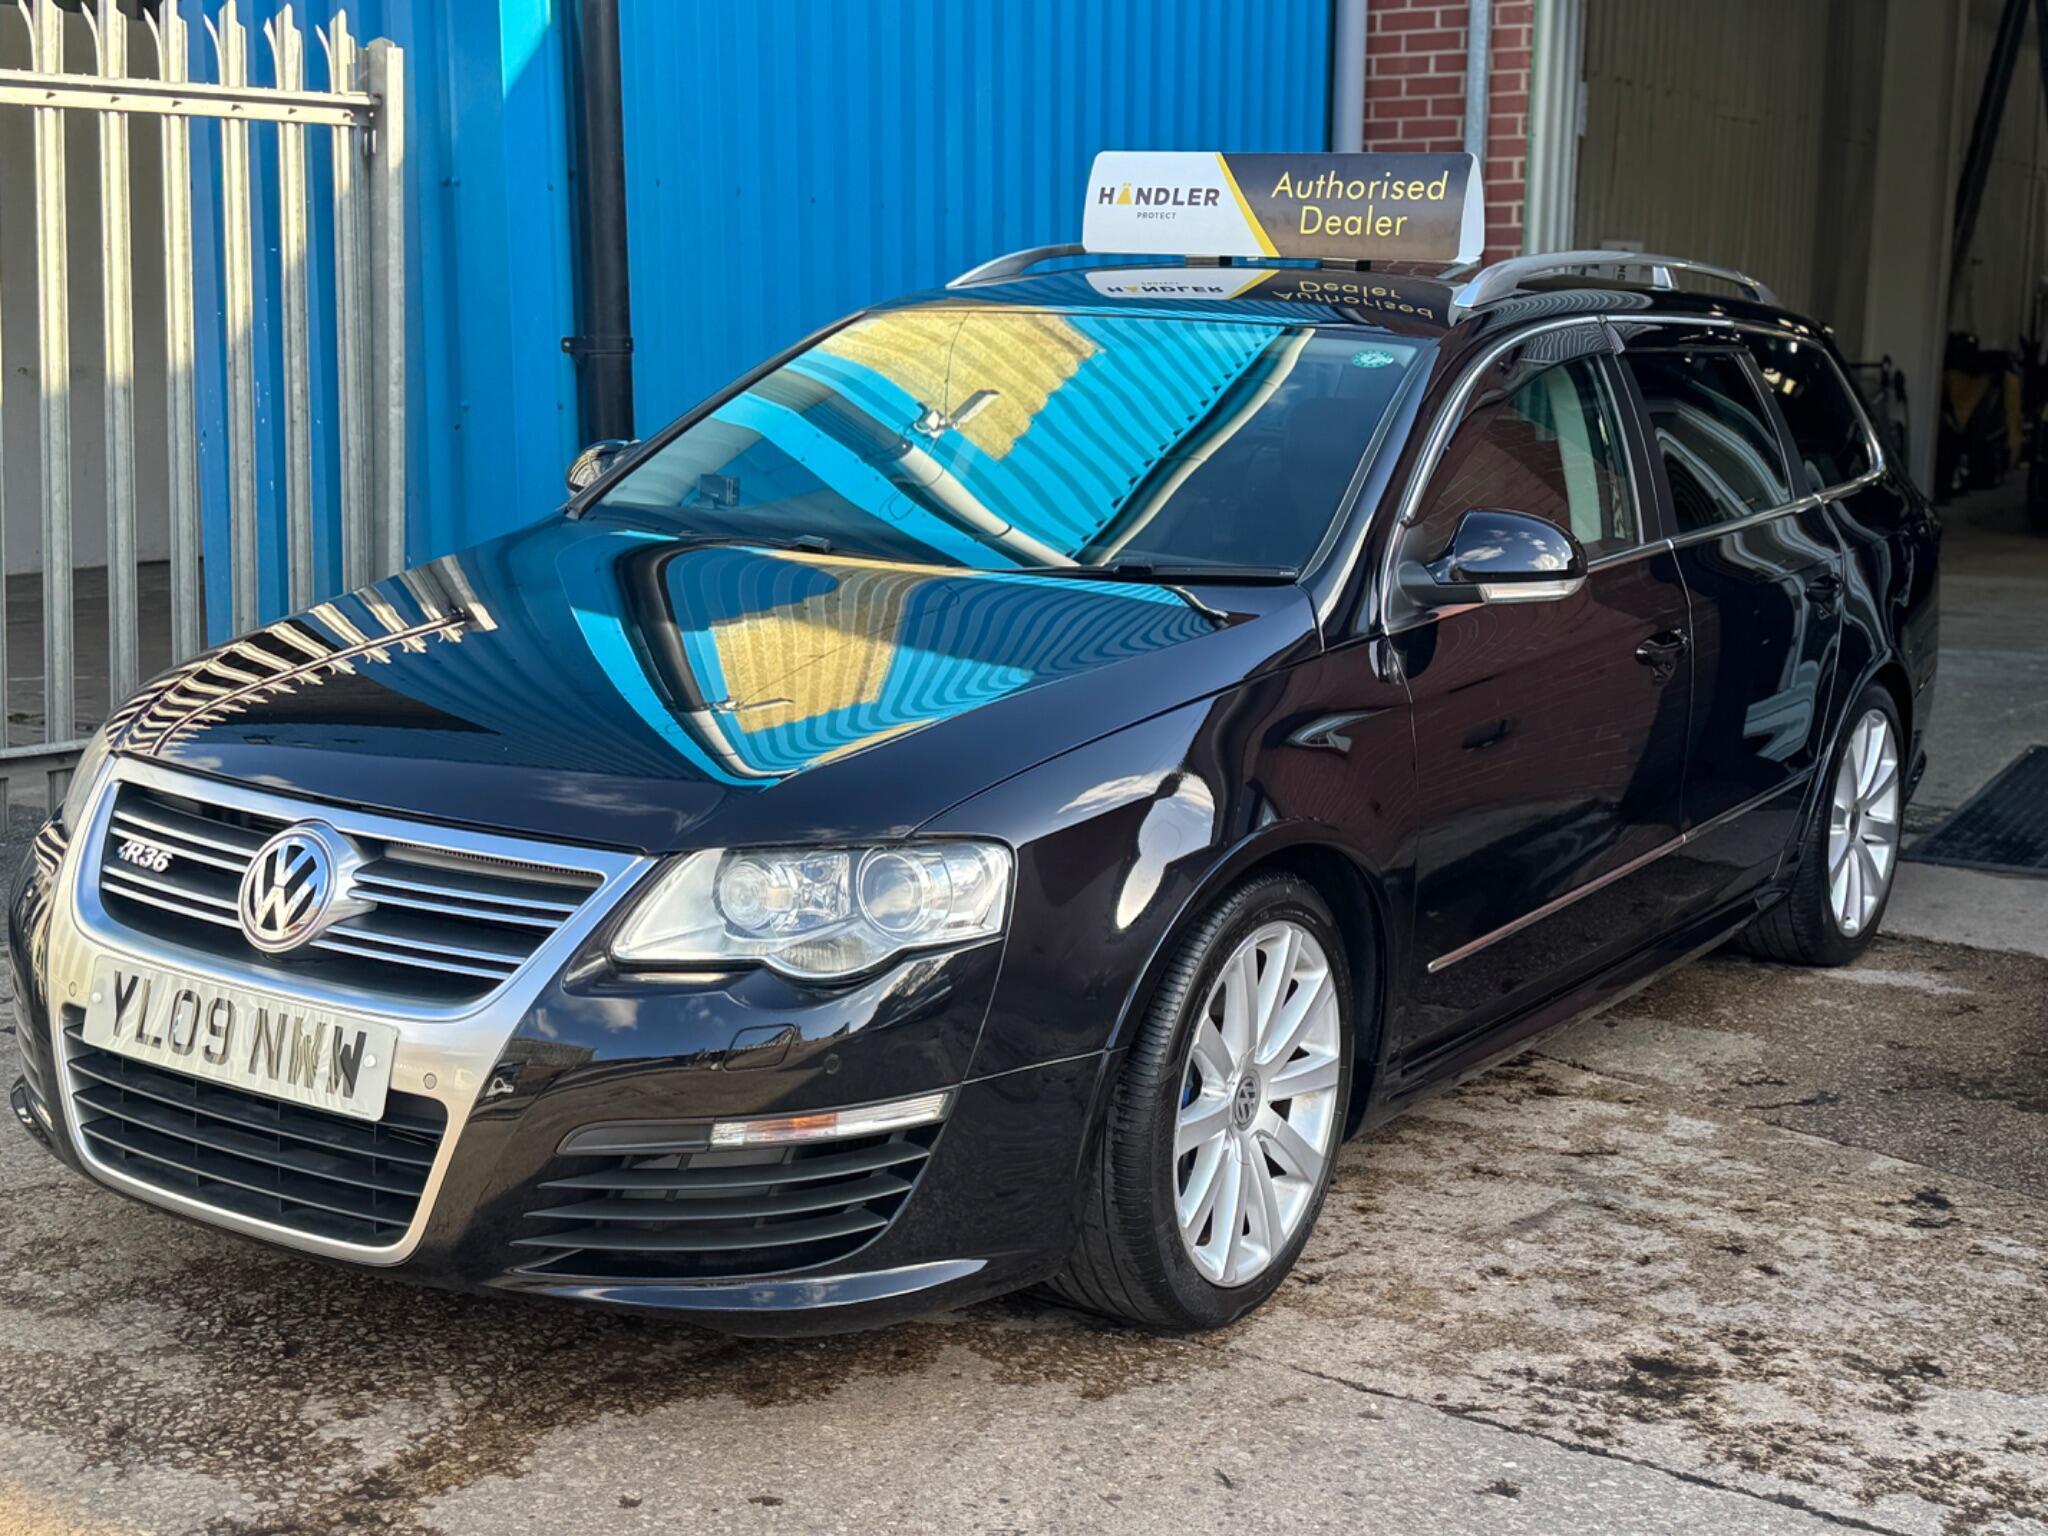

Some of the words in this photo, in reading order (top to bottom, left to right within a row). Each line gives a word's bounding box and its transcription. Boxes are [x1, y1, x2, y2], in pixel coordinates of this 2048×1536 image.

[1270, 170, 1449, 200] Authorised
[1136, 211, 1176, 220] PROTECT
[1300, 204, 1408, 237] Dealer
[122, 841, 174, 873] R36
[113, 970, 237, 1066] YL09
[248, 1008, 367, 1099] NWW
